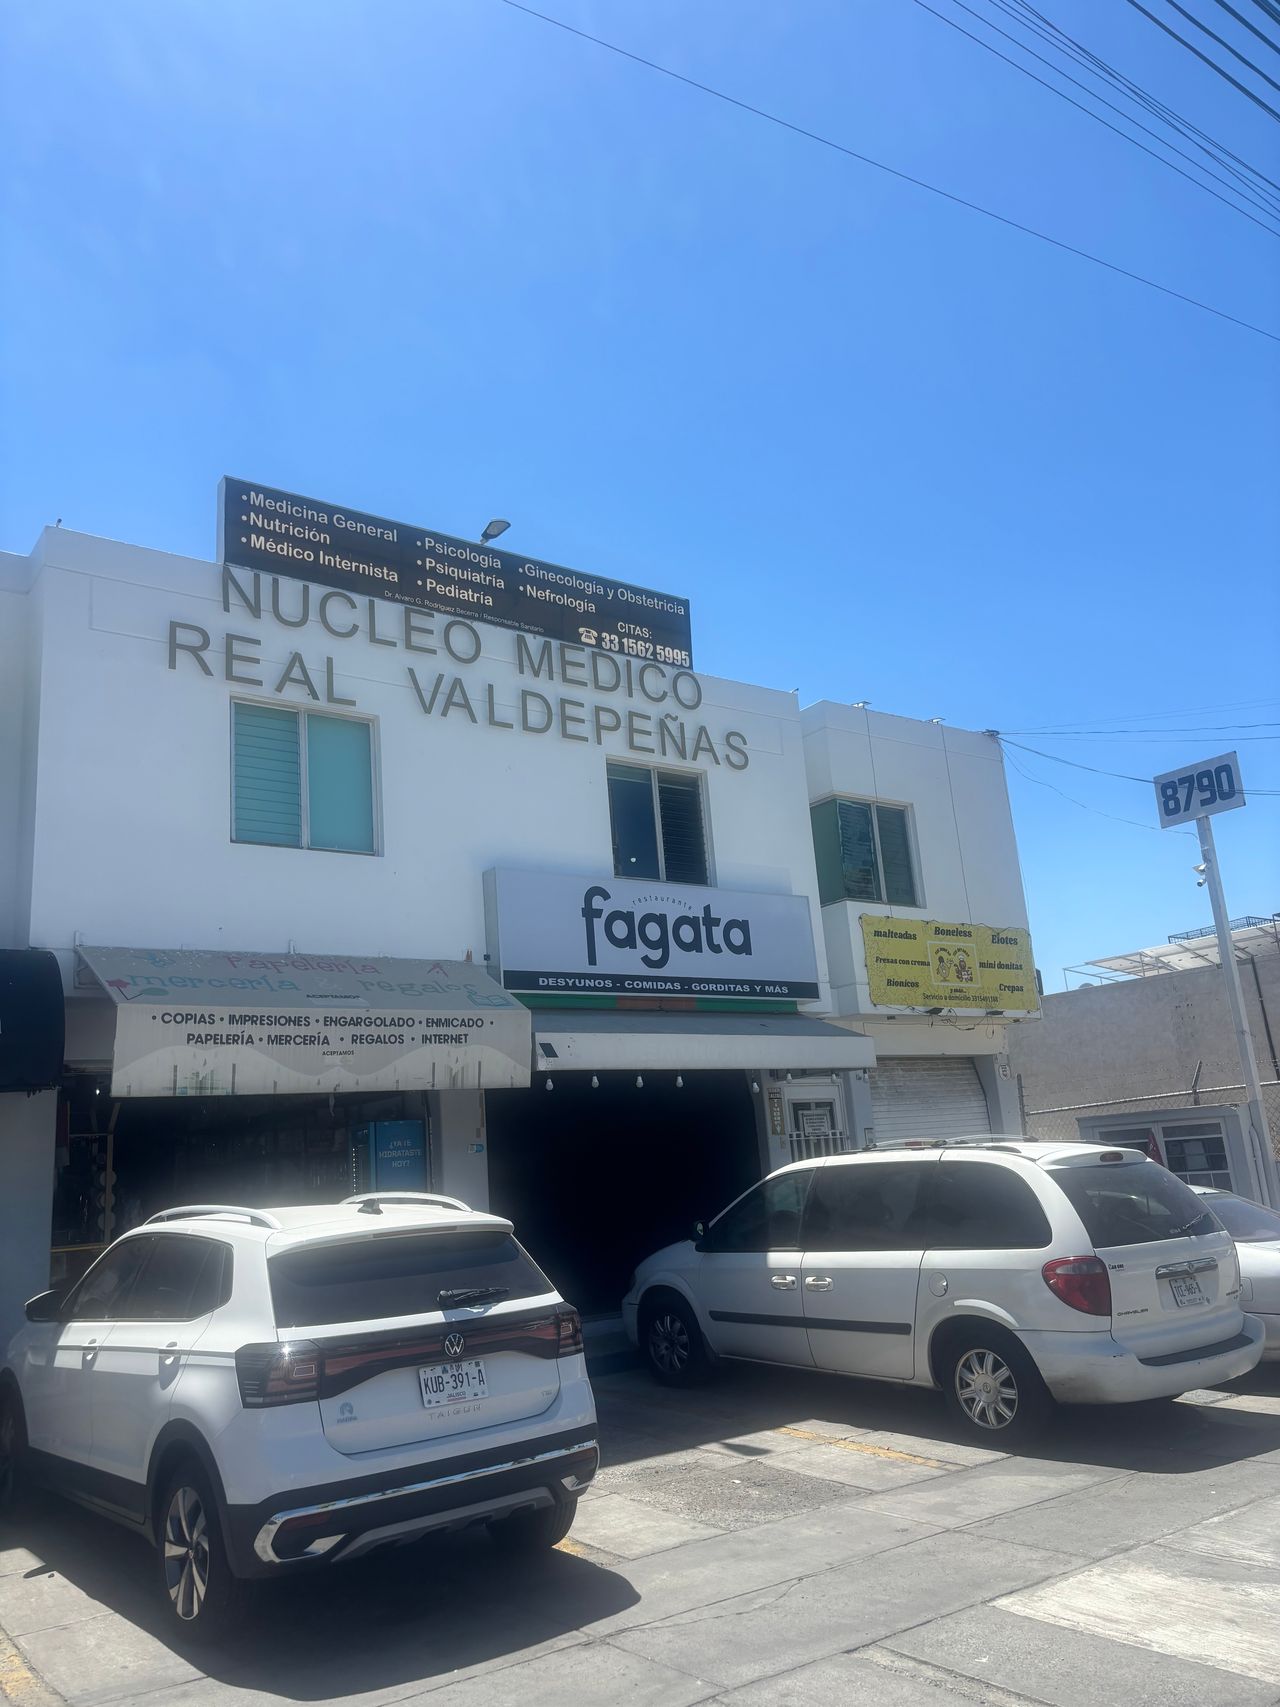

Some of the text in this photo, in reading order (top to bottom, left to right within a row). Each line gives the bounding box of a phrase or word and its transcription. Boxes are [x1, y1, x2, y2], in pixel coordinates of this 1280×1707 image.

[250, 491, 398, 542] Medicina General
[249, 512, 330, 545] Nutrición
[250, 534, 399, 583] Médico Internista
[425, 537, 501, 569] Psicología
[426, 558, 505, 590] Psiquiatría
[384, 590, 394, 598] Dr.
[426, 579, 493, 607] Pediatría
[525, 563, 685, 616] Ginecología y Obstetricia
[526, 584, 596, 614] Nefrología
[222, 567, 703, 710] NUCLEO MEDICO
[617, 621, 652, 639] CITAS:
[601, 633, 690, 668] 33 1562 5995
[168, 620, 749, 770] REAL VALDEPEÑAS
[1160, 764, 1236, 816] 8790
[632, 895, 692, 911] restaurante
[581, 885, 752, 969] fagata
[873, 928, 917, 941] malteadas
[934, 926, 972, 938] Boneless
[991, 933, 1018, 946] Elotes
[222, 954, 382, 975] Papelería
[875, 956, 930, 967] Fresas con crema
[979, 960, 1023, 971] mini donitas
[127, 974, 301, 992] mercería
[357, 978, 477, 996] regalos
[538, 977, 789, 994] DESYUNOS COMIDAS GORDITAS Y MÁS
[999, 983, 1024, 993] Crepas
[161, 1012, 484, 1028] COPIAS IMPRESIONES ENGARGOLADO ENMICADO
[186, 1031, 469, 1046] PAPELERÍA MERCERÍA REGALOS INTERNET
[423, 1369, 485, 1395] KUB-391-A
[428, 1403, 481, 1420] TAIGUN
